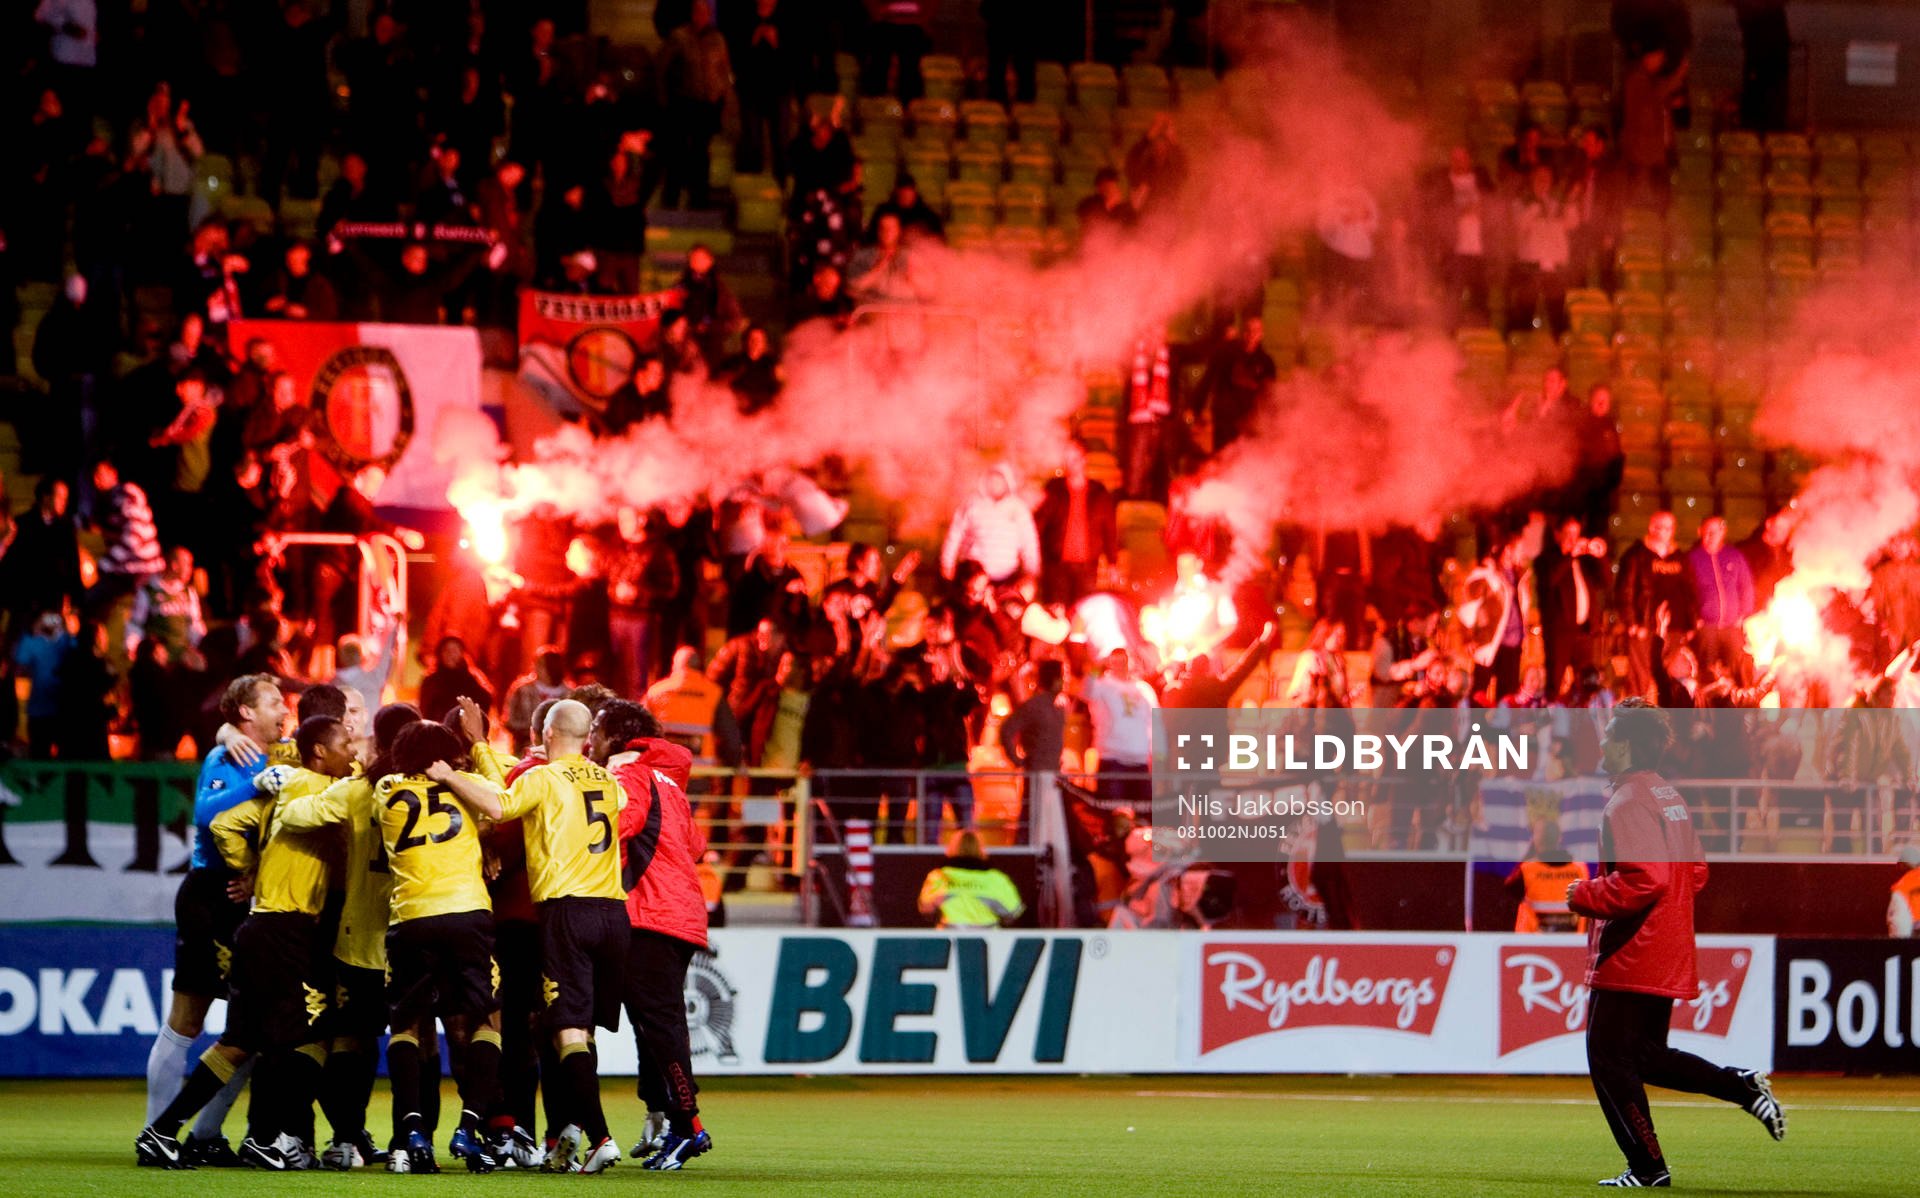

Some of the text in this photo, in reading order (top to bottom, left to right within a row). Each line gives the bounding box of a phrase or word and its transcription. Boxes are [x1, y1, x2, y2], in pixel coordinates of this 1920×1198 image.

[386, 785, 463, 853] 25
[583, 790, 613, 854] 5
[763, 937, 1085, 1064] BEVI
[1208, 952, 1435, 1029] Rydbergs
[1505, 953, 1730, 1031] Rygs
